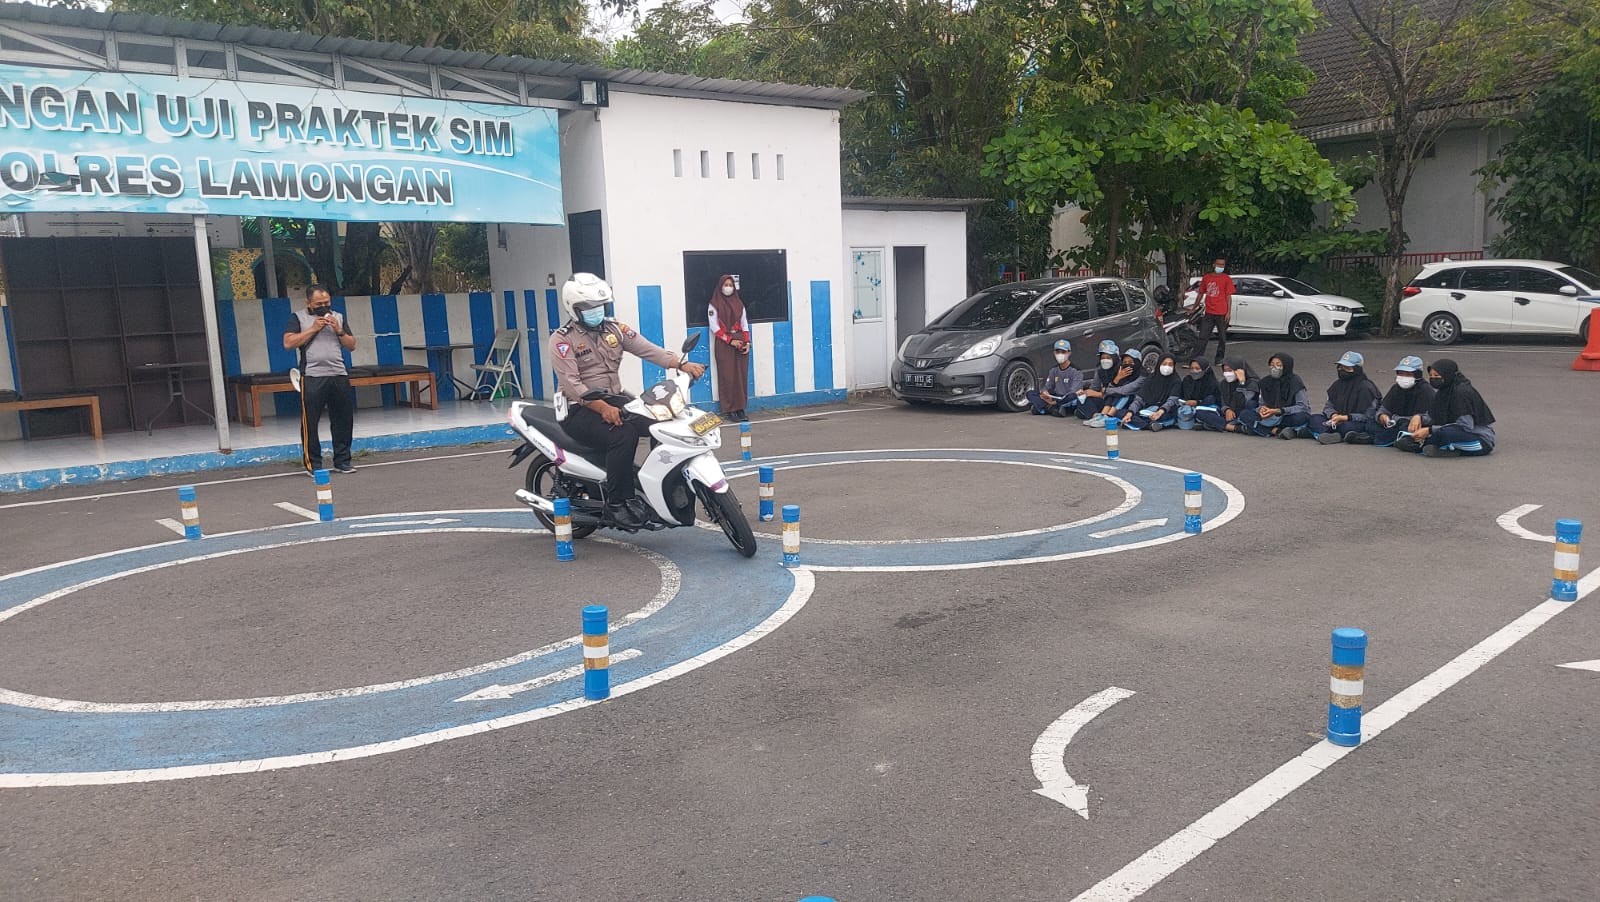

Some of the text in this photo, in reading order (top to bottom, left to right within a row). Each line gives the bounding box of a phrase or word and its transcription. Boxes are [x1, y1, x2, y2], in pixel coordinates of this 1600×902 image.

[0, 84, 513, 155] NGAN UJI PRAKTEK SIM
[198, 158, 452, 204] LAMONGAN
